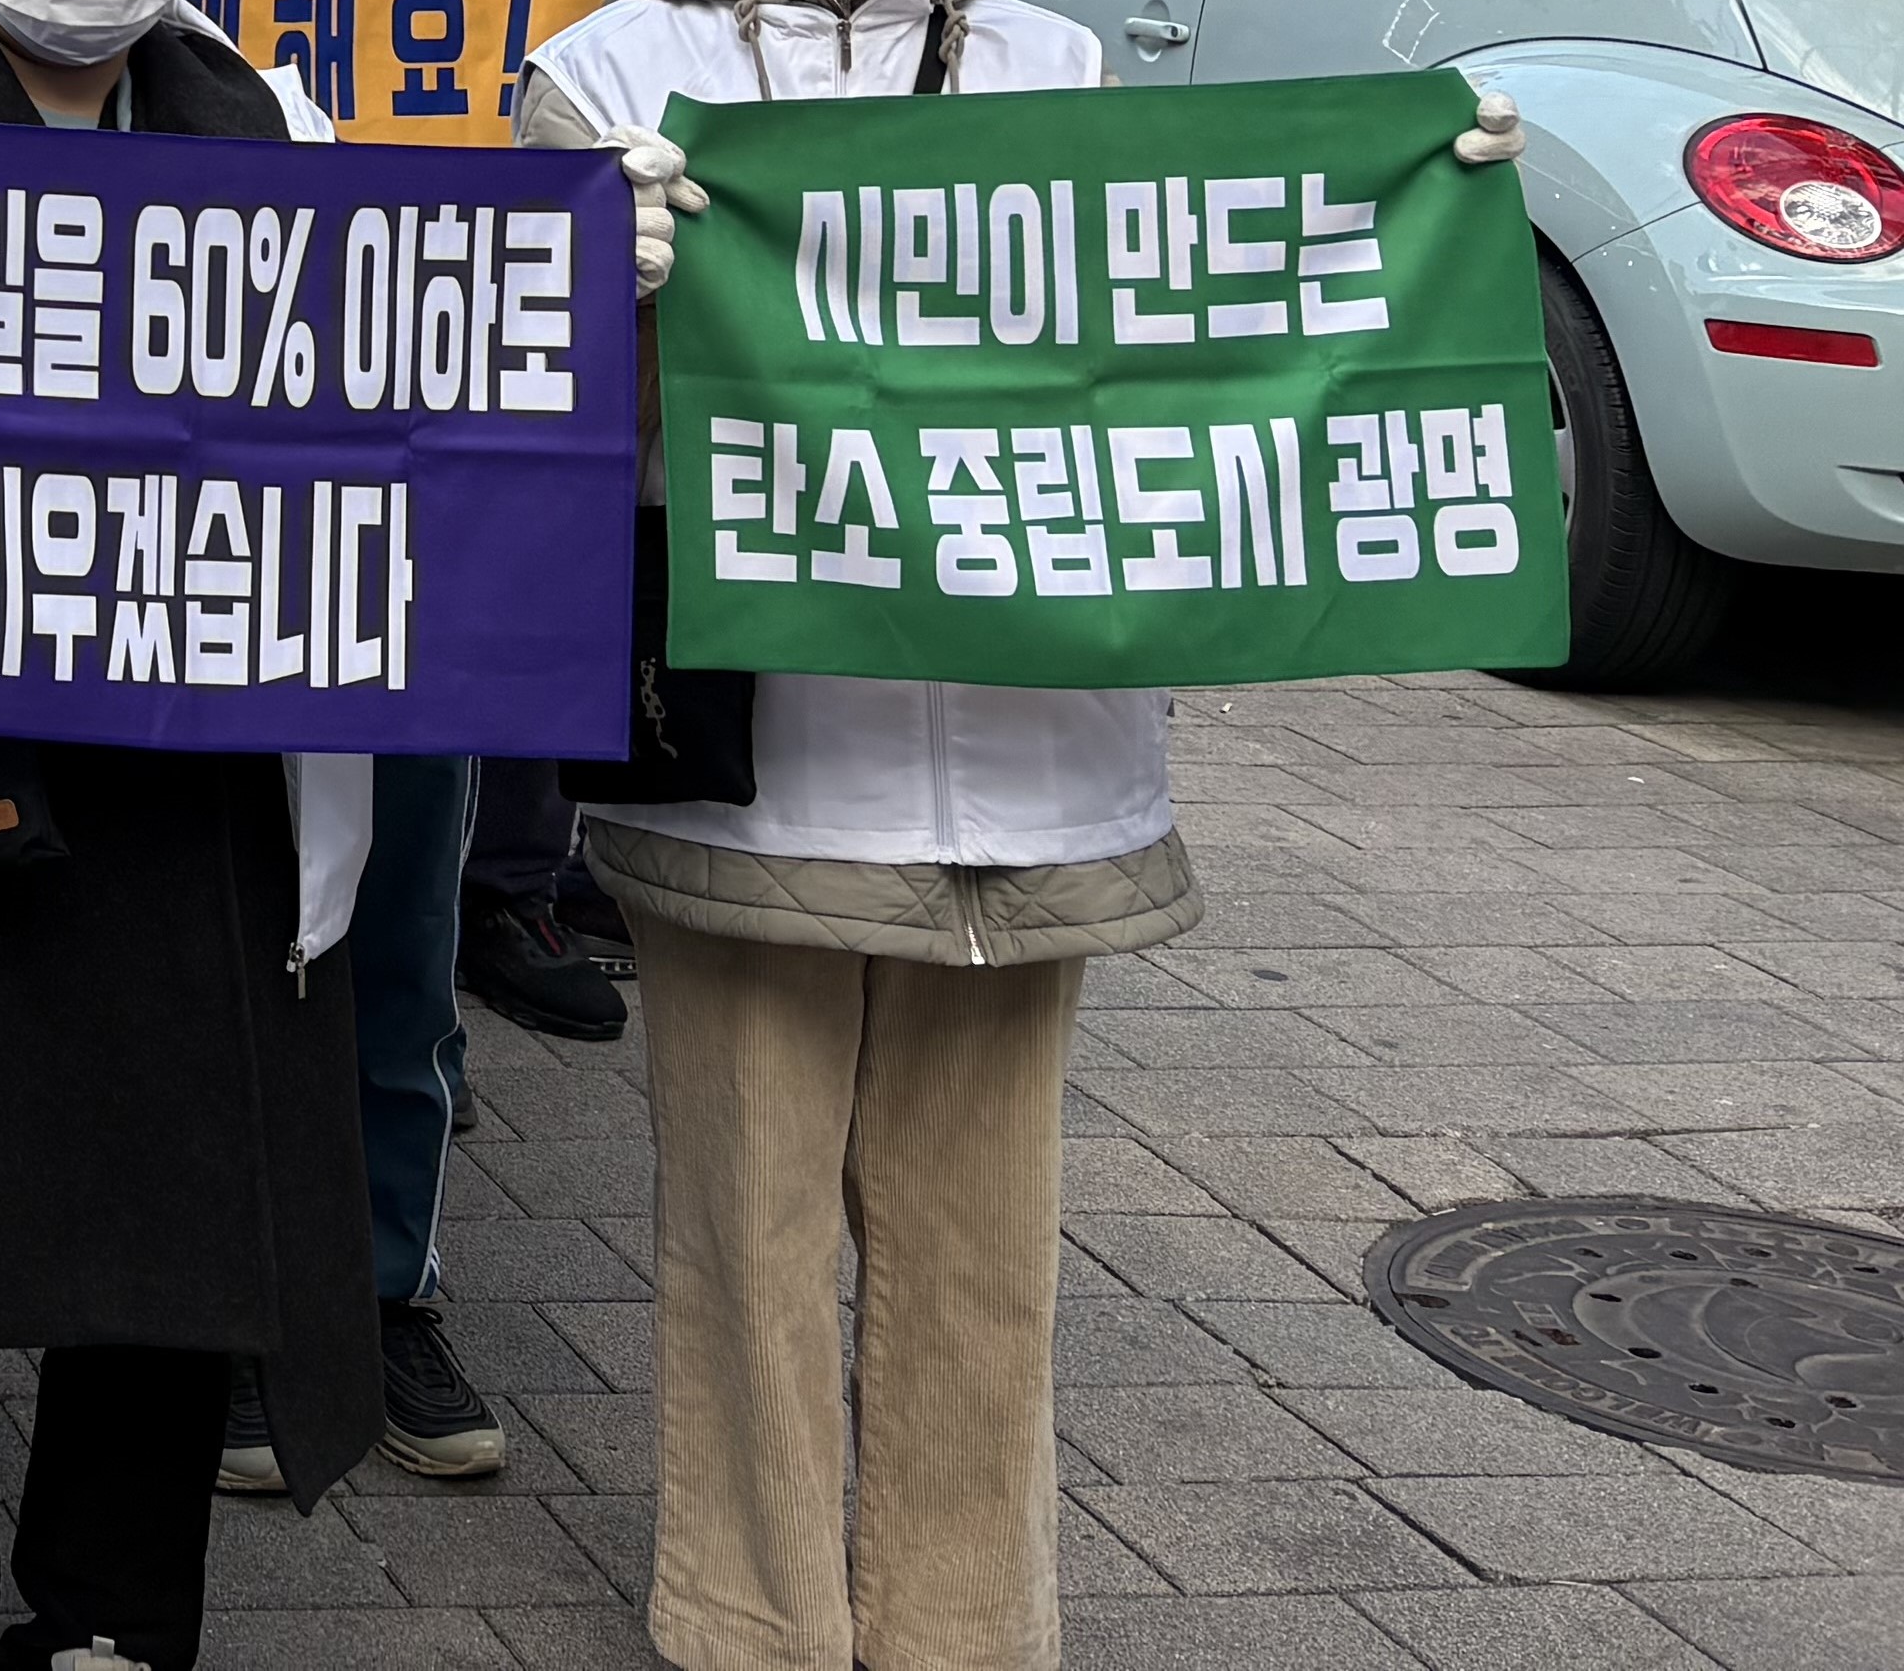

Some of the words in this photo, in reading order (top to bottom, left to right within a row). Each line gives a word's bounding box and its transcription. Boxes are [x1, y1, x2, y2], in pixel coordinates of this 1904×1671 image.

[129, 204, 315, 408] 60%
[342, 206, 577, 415] 이하로
[794, 176, 1081, 350] 시민이
[1104, 168, 1394, 342] 만드는
[711, 414, 906, 592] 탄소
[923, 414, 1308, 600] 중립도시
[1322, 401, 1518, 583] 광명
